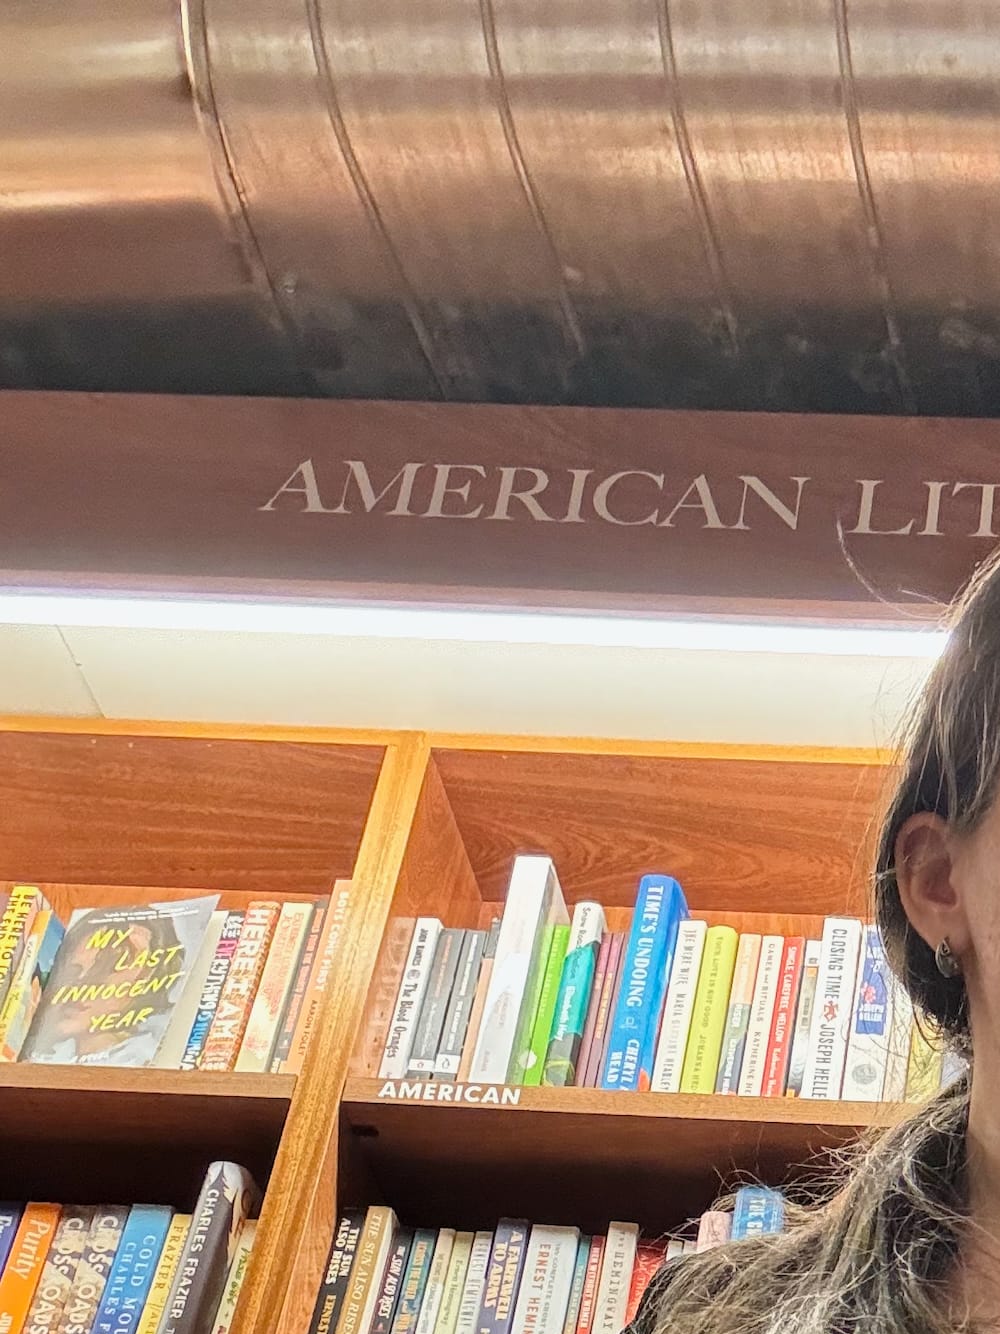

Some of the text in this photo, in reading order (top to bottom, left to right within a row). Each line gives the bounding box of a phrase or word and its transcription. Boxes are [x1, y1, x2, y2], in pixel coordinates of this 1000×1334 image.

[258, 457, 811, 531] AMERICAN
[87, 927, 132, 949] MY
[115, 945, 185, 971] LAST
[314, 891, 349, 992] BOYS COME FIRST
[626, 886, 665, 1008] TIME'S UNDOING
[51, 970, 186, 1005] INNOCENT
[212, 908, 271, 1040] HERE AM
[815, 928, 847, 1064] CLOSING TIME JOSEPH
[89, 1006, 154, 1034] YEAR
[386, 1001, 414, 1059] Blood Oranges
[773, 974, 794, 1043] CAREFREE, MELLOW
[606, 1051, 623, 1083] HEAD
[622, 1039, 641, 1083] CHERYL
[745, 1031, 762, 1081] KATHERINE
[378, 1082, 521, 1105] AMERICAN
[9, 1219, 50, 1280] Purity
[190, 1189, 220, 1253] CHARLES
[366, 1213, 382, 1237] THE
[104, 1242, 137, 1315] CHARLES
[130, 1234, 157, 1287] COLD
[154, 1225, 184, 1290] FRAZIER
[325, 1218, 350, 1285] ALSO RISES
[340, 1227, 360, 1277] THE SUN
[360, 1240, 377, 1265] SUN
[485, 1242, 508, 1308] TO ARMS
[531, 1243, 552, 1290] ERNEST
[169, 1257, 199, 1319] FRAZIER
[352, 1268, 370, 1299] ALSO
[494, 1246, 521, 1320] FAREWELL
[603, 1251, 626, 1330] HEMINGWAY
